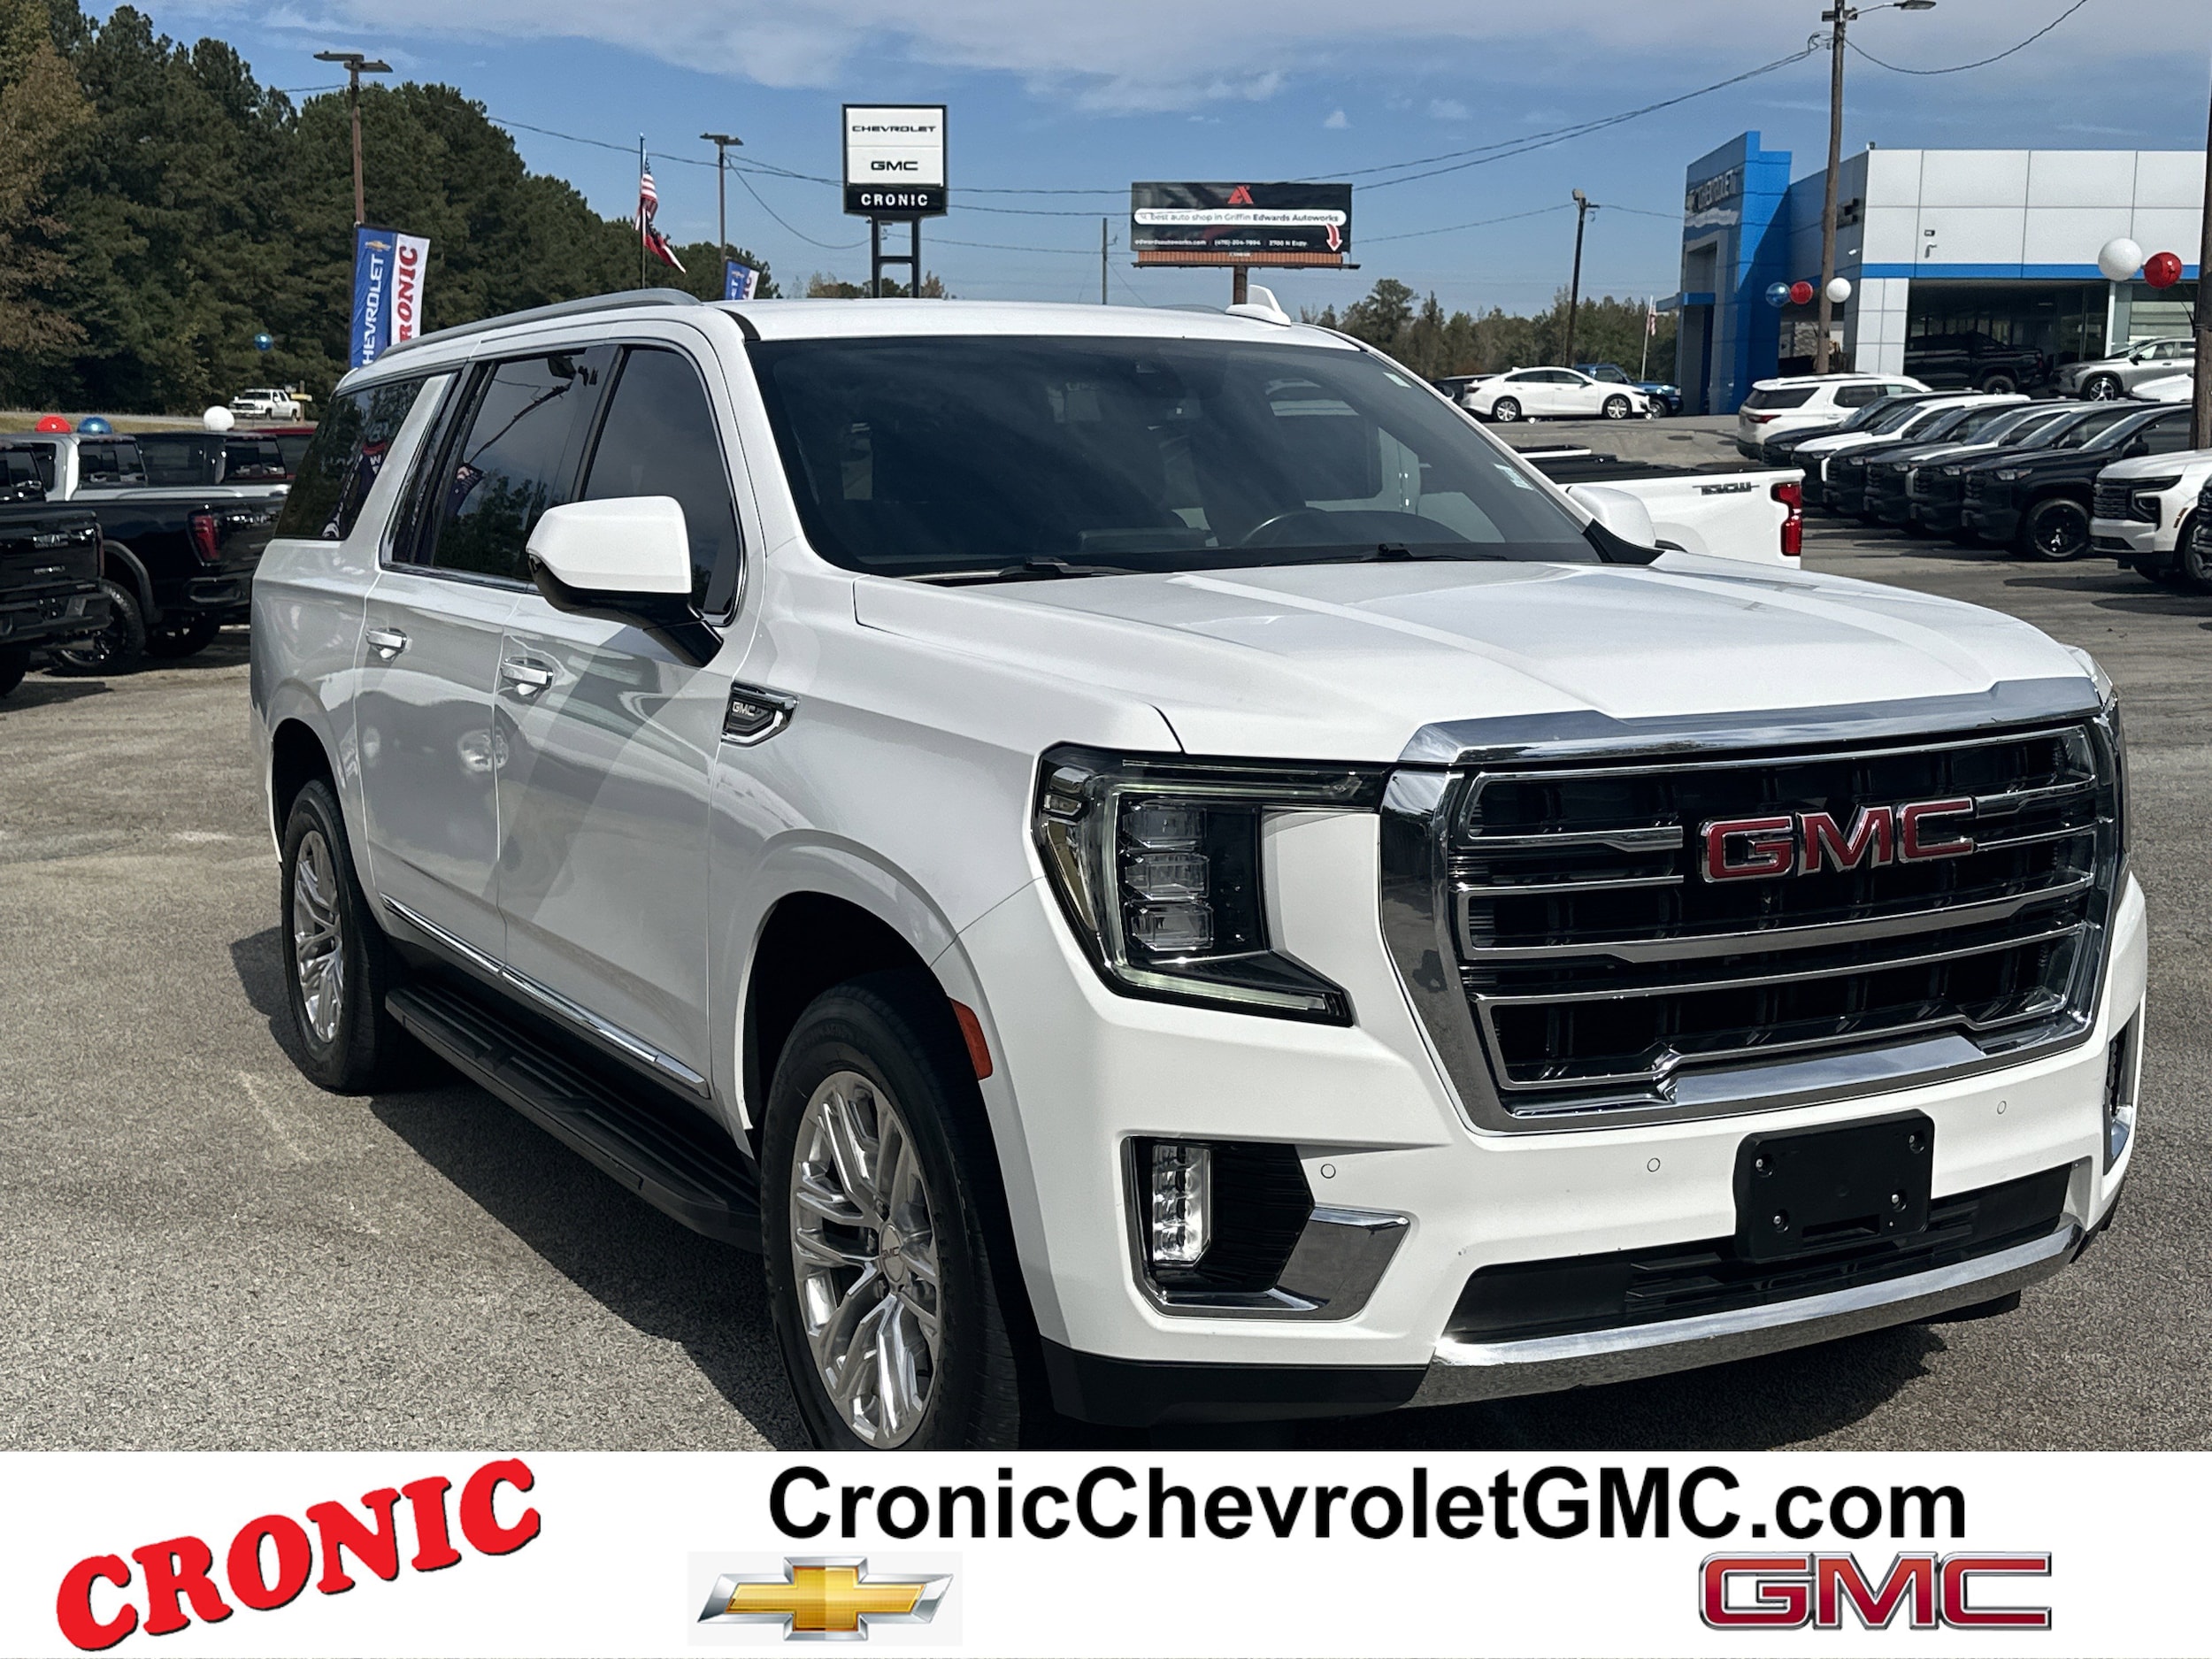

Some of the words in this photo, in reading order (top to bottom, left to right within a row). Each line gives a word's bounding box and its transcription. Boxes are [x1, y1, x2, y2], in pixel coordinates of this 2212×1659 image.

[871, 161, 918, 171] GMC
[861, 194, 928, 206] CRONIC
[1192, 213, 1213, 222] shop
[397, 244, 419, 343] RONIC
[362, 253, 384, 365] HEVROLET
[732, 701, 757, 717] GMC
[1700, 797, 1974, 883] GMC
